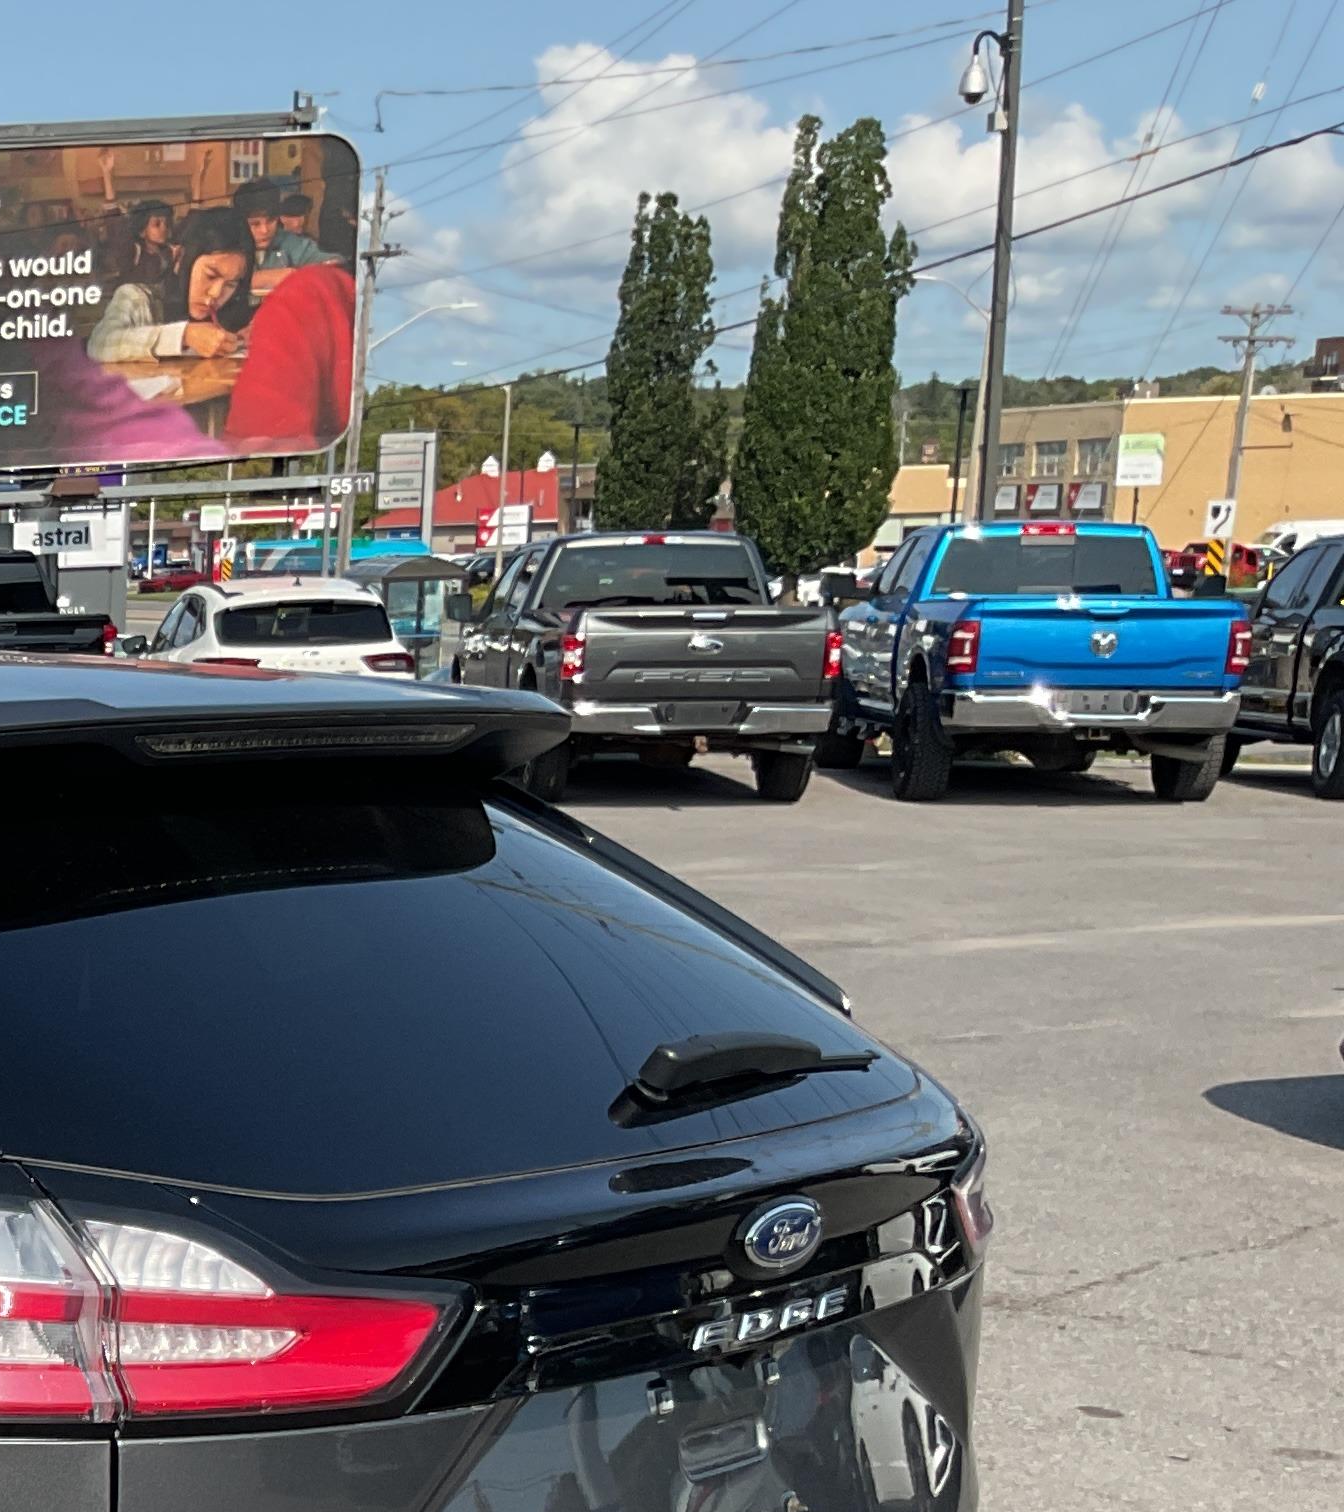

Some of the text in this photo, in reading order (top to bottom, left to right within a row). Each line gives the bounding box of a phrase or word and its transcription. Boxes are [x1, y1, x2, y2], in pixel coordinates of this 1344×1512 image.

[9, 249, 92, 278] would
[0, 312, 74, 341] child.
[31, 526, 90, 547] astral
[767, 1215, 812, 1255] Ford
[690, 1284, 848, 1351] EDGE
